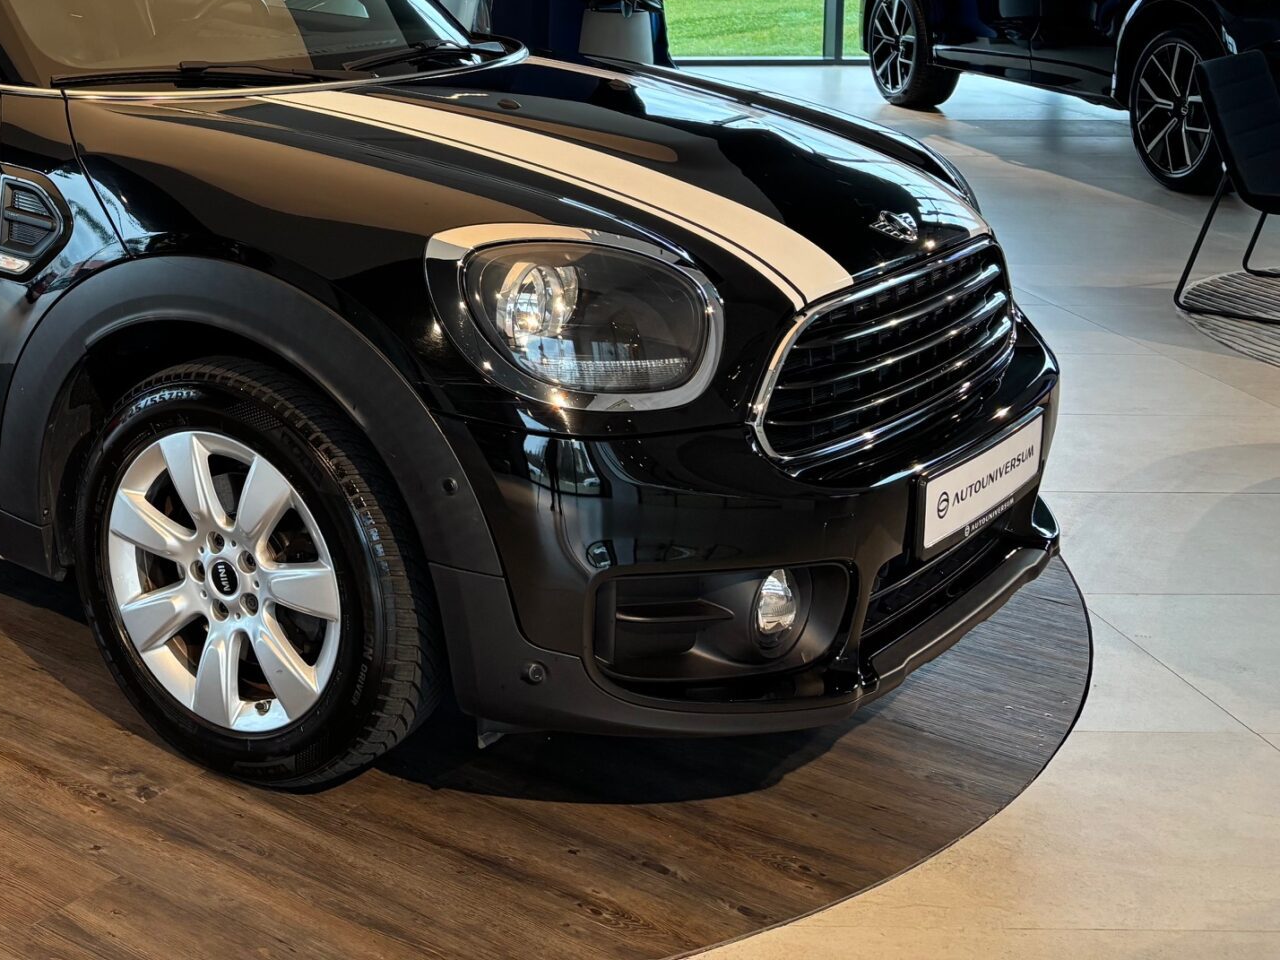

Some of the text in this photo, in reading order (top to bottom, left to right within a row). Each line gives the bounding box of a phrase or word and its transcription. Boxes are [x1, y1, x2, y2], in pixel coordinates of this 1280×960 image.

[952, 444, 1035, 508] AUTOUNIVERSUM
[971, 497, 1015, 531] AUTOUNIVERSUM
[217, 565, 231, 592] MINI
